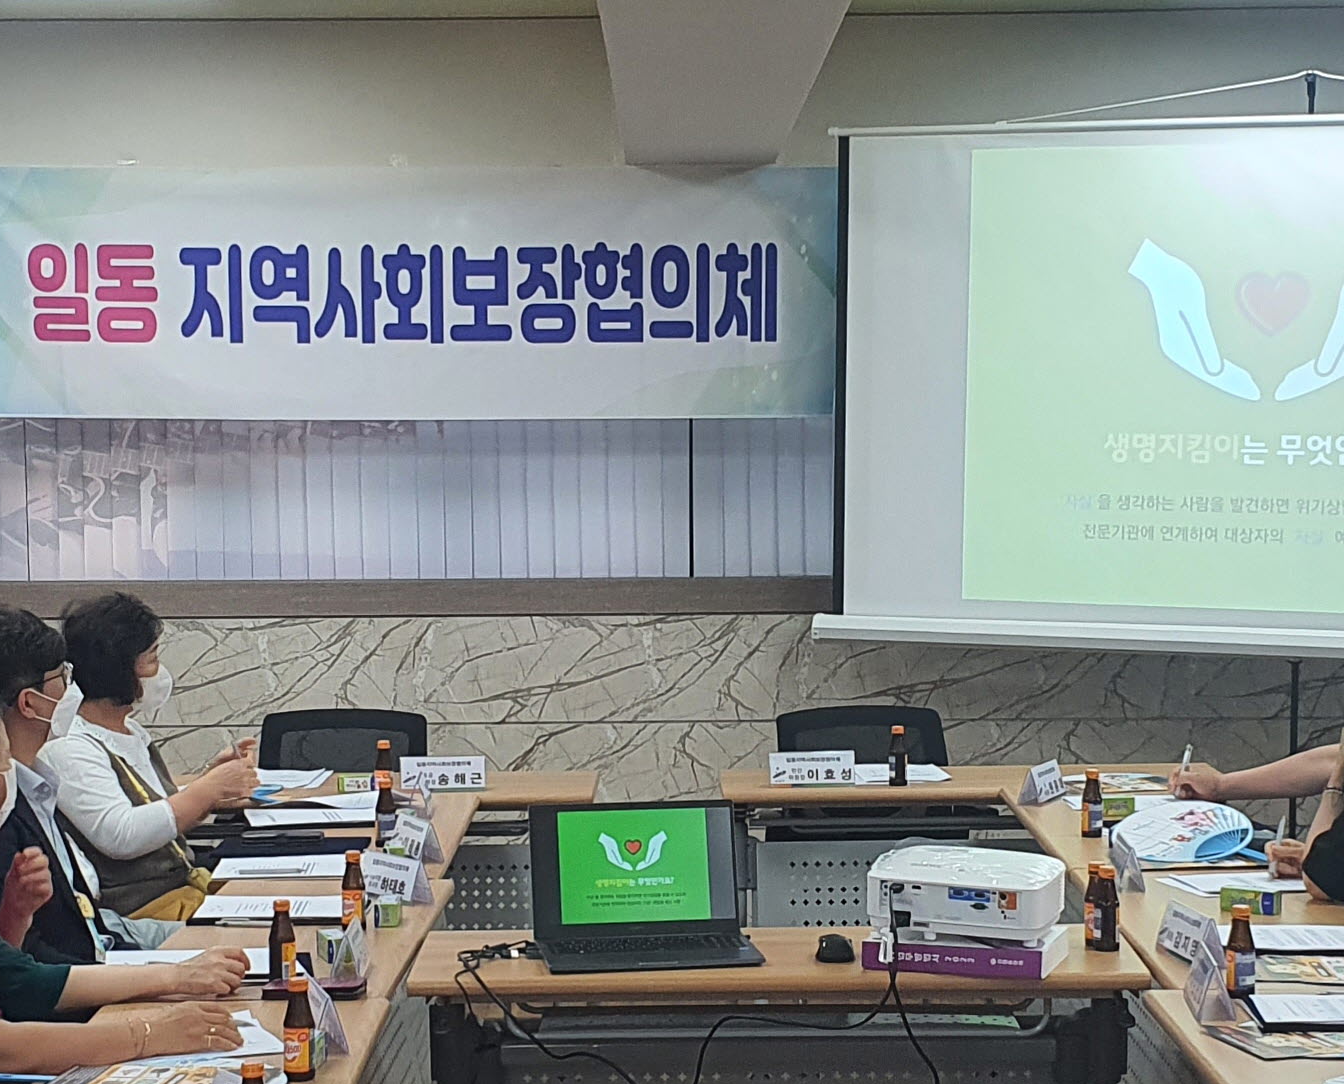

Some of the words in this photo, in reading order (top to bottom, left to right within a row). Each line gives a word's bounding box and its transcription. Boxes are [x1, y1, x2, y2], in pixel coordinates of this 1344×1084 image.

[27, 241, 158, 344] 일동
[178, 241, 779, 345] 지역사회보장협의체
[1116, 494, 1175, 512] 생각하는
[1180, 495, 1225, 513] 사람을
[1230, 497, 1290, 515] 발견하면
[1082, 523, 1155, 542] 전문기관에
[1160, 525, 1218, 543] 연계하여
[1223, 527, 1285, 545] 대상자의
